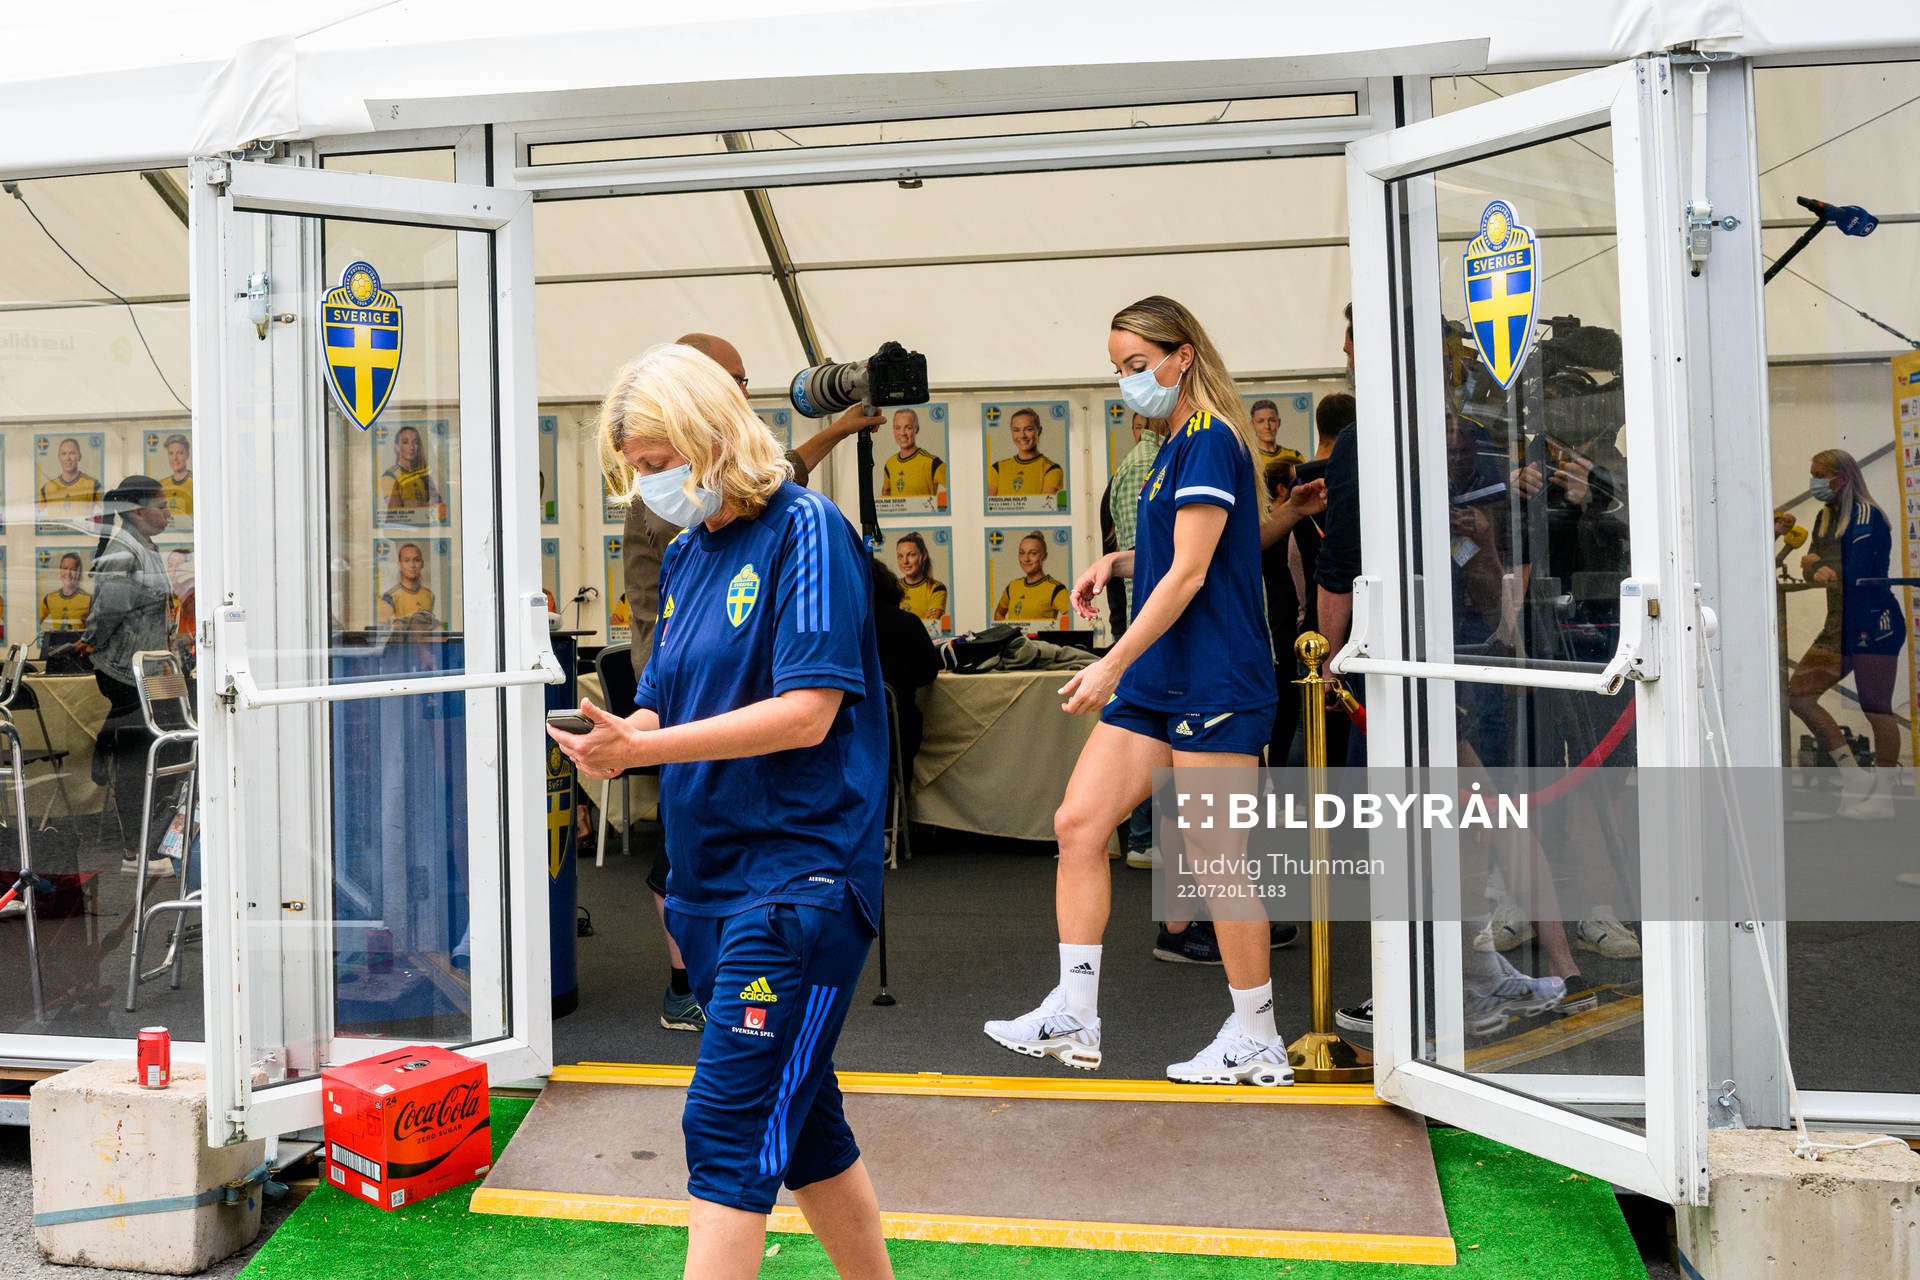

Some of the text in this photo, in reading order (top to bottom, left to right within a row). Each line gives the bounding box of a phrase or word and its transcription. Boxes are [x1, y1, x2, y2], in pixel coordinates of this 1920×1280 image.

[1474, 252, 1524, 272] SVERIGE
[334, 310, 390, 323] SVERIGE
[740, 990, 777, 1002] adidas
[732, 1027, 758, 1035] SVENSKA
[385, 1096, 398, 1107] 24
[394, 1080, 481, 1141] Coca-Cola
[417, 1124, 463, 1144] ZERO SUGAR
